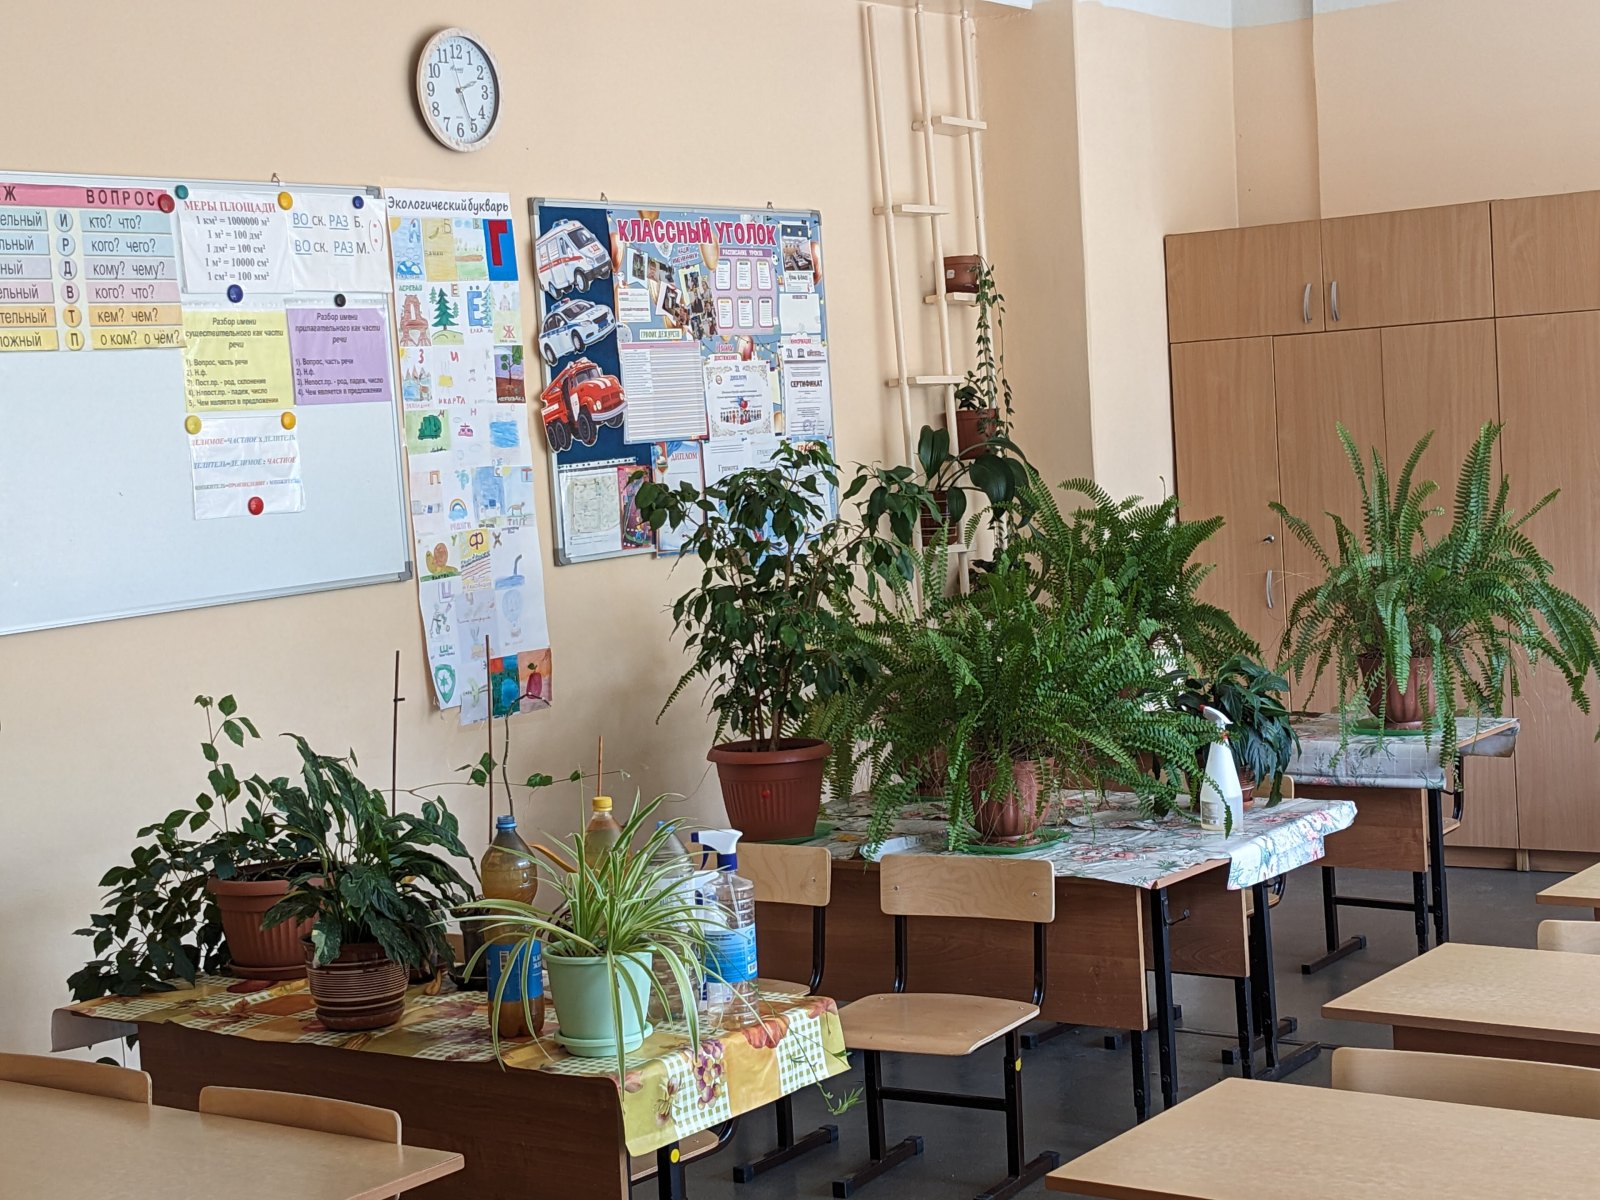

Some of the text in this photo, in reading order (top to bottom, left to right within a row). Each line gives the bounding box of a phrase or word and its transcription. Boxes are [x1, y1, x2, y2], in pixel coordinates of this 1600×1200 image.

[437, 46, 449, 64] 11
[450, 44, 462, 60] 12
[466, 50, 472, 65] 1
[428, 62, 440, 78] 10
[477, 65, 484, 80] 2
[427, 82, 435, 96] 9
[482, 85, 488, 100] 3
[432, 102, 440, 117] 8
[478, 105, 486, 120] 4
[444, 117, 450, 132] 7
[457, 122, 464, 138] 6
[470, 118, 478, 133] 5
[86, 189, 155, 206] ВОПРОС
[184, 200, 276, 214] МЕРЫ ПЛОЩАДИ
[0, 212, 43, 227] ельный
[60, 214, 68, 224] И
[89, 214, 142, 230] кто? что?
[196, 216, 200, 224] 1
[292, 213, 308, 226] ВО
[329, 215, 348, 228] РАЗ
[354, 216, 364, 228] Б.
[208, 230, 212, 238] 1
[234, 230, 248, 240] 100
[617, 218, 777, 245] КЛАССНЫЙ УГОЛОК
[62, 238, 70, 250] Р
[91, 238, 156, 253] кого? чего?
[206, 244, 210, 252] 1
[238, 244, 252, 253] 100
[295, 240, 310, 252] ВО
[334, 241, 354, 254] РАЗ
[356, 242, 370, 254] М.
[488, 220, 508, 266] Г
[64, 261, 72, 275] Д
[205, 258, 209, 266] 1
[232, 258, 255, 267] 10000
[93, 261, 165, 280] кому? чему?
[208, 272, 212, 280] 1
[238, 272, 252, 280] 100
[66, 287, 74, 299] В
[95, 284, 154, 300] кого? что?
[68, 310, 76, 324] Т
[98, 308, 158, 323] кем? чем?
[212, 317, 235, 326] Разбор
[316, 312, 338, 322] Разбор
[70, 333, 79, 346] П
[100, 330, 180, 346] о ком? о чём?
[228, 342, 244, 350] речи
[670, 452, 698, 462] ДИПЛОМ
[718, 464, 739, 474] Грамота
